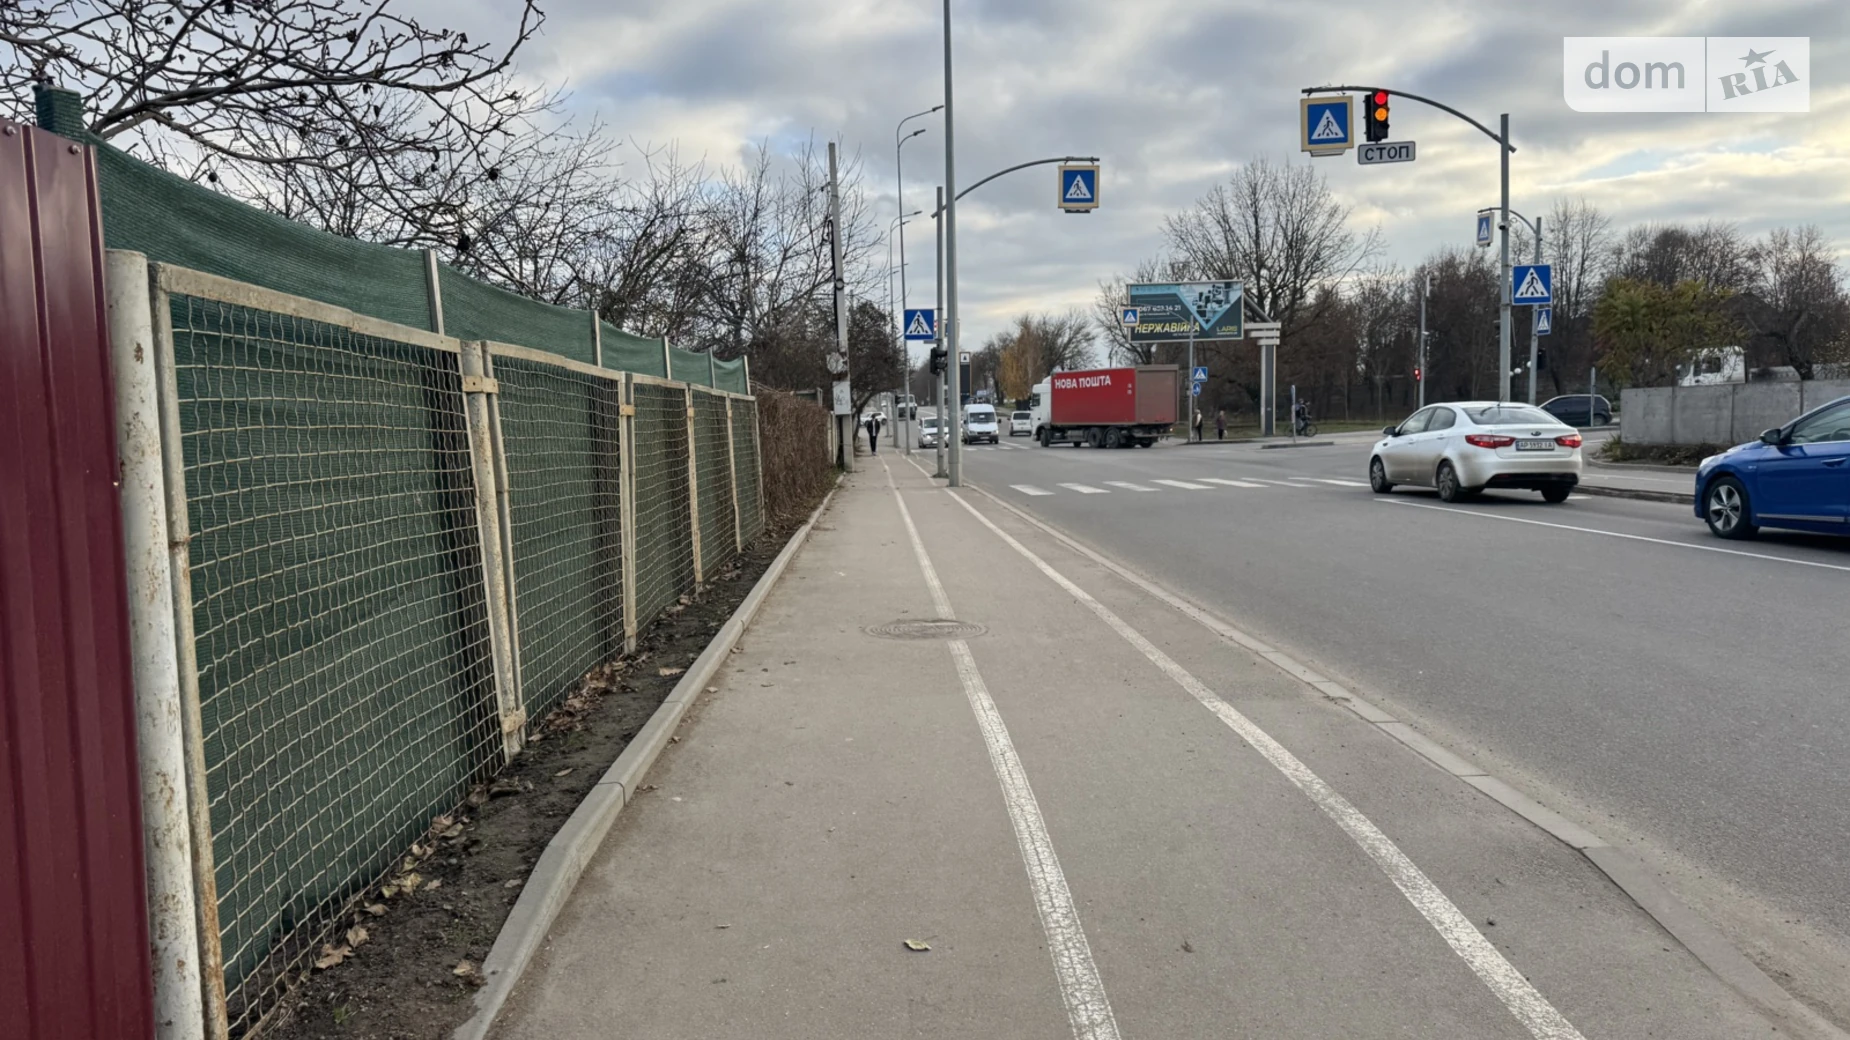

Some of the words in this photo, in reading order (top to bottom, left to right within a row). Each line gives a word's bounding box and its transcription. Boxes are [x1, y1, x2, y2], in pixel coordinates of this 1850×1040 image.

[1364, 145, 1410, 161] СТОП
[1054, 378, 1078, 390] НОВА
[1079, 374, 1112, 388] ПОШТА
